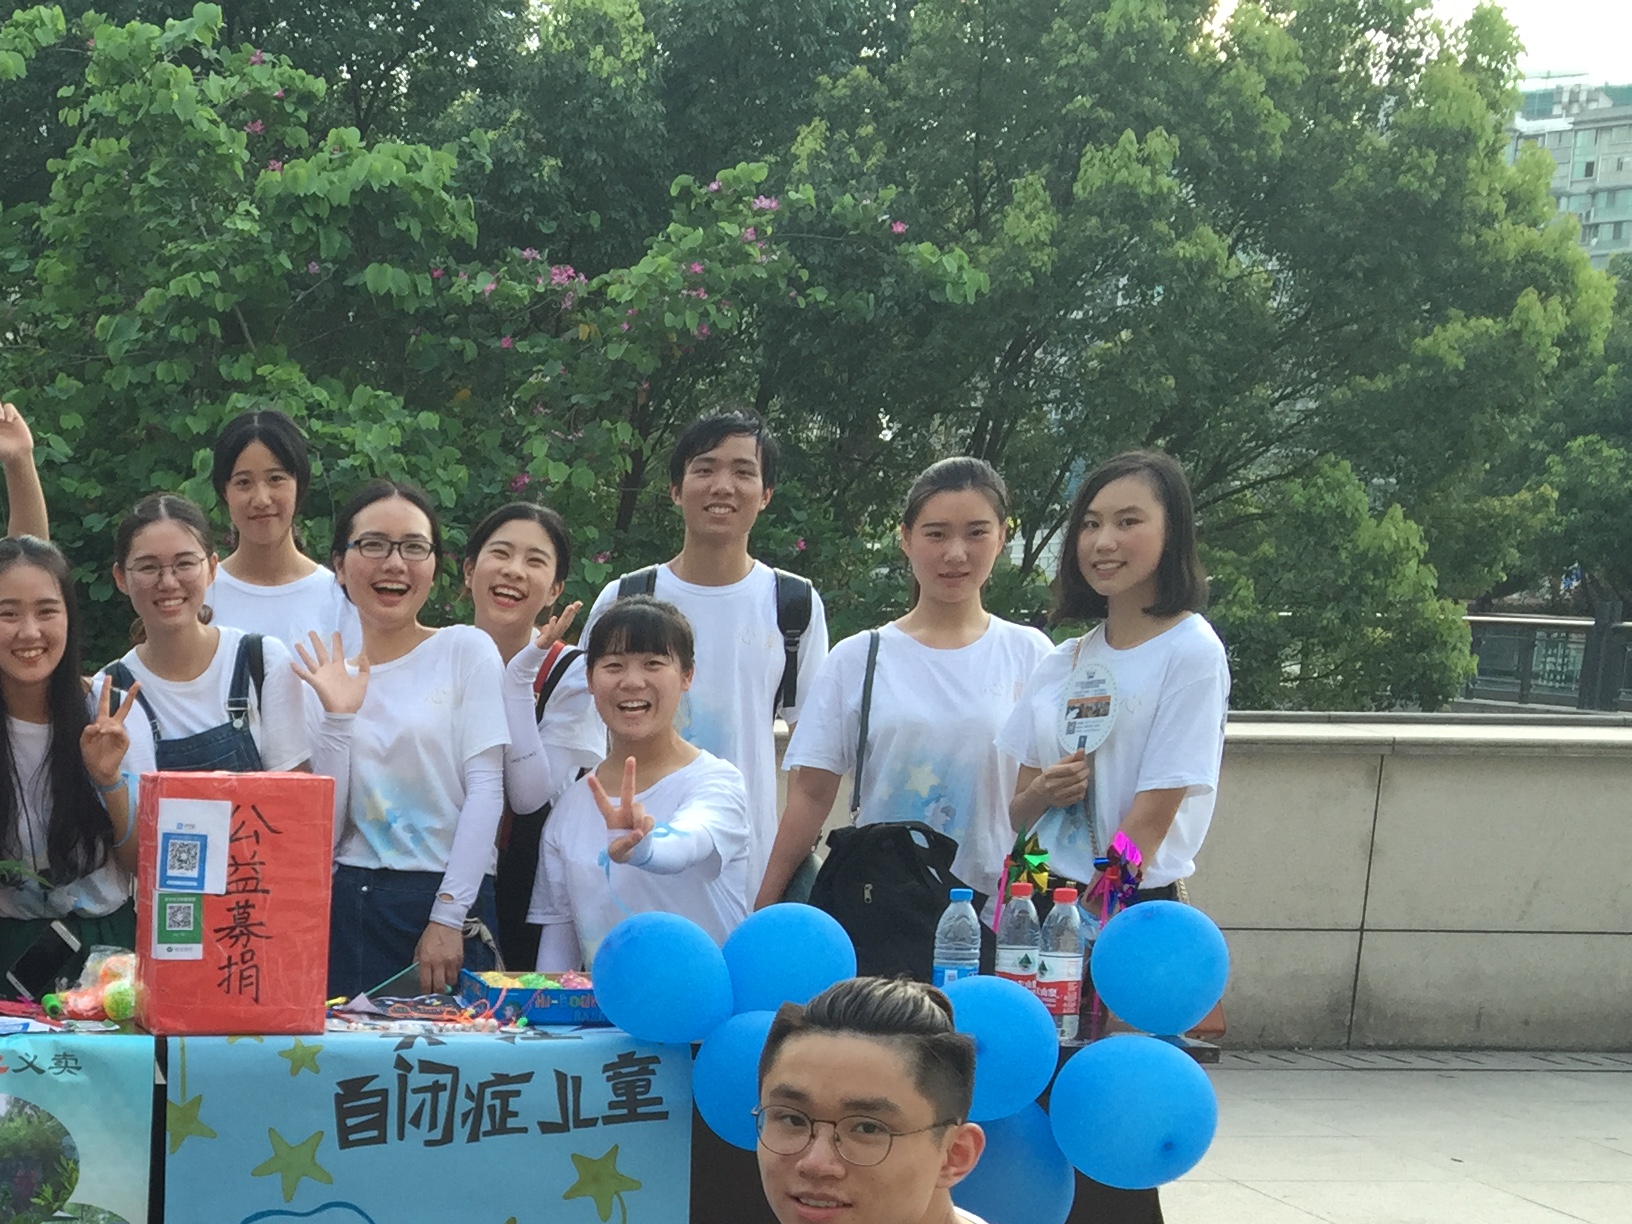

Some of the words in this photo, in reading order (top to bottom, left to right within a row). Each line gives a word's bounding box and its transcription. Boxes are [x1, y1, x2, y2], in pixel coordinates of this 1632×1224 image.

[212, 804, 283, 1004] 公益募捐
[333, 1051, 669, 1150] 自闭症儿童
